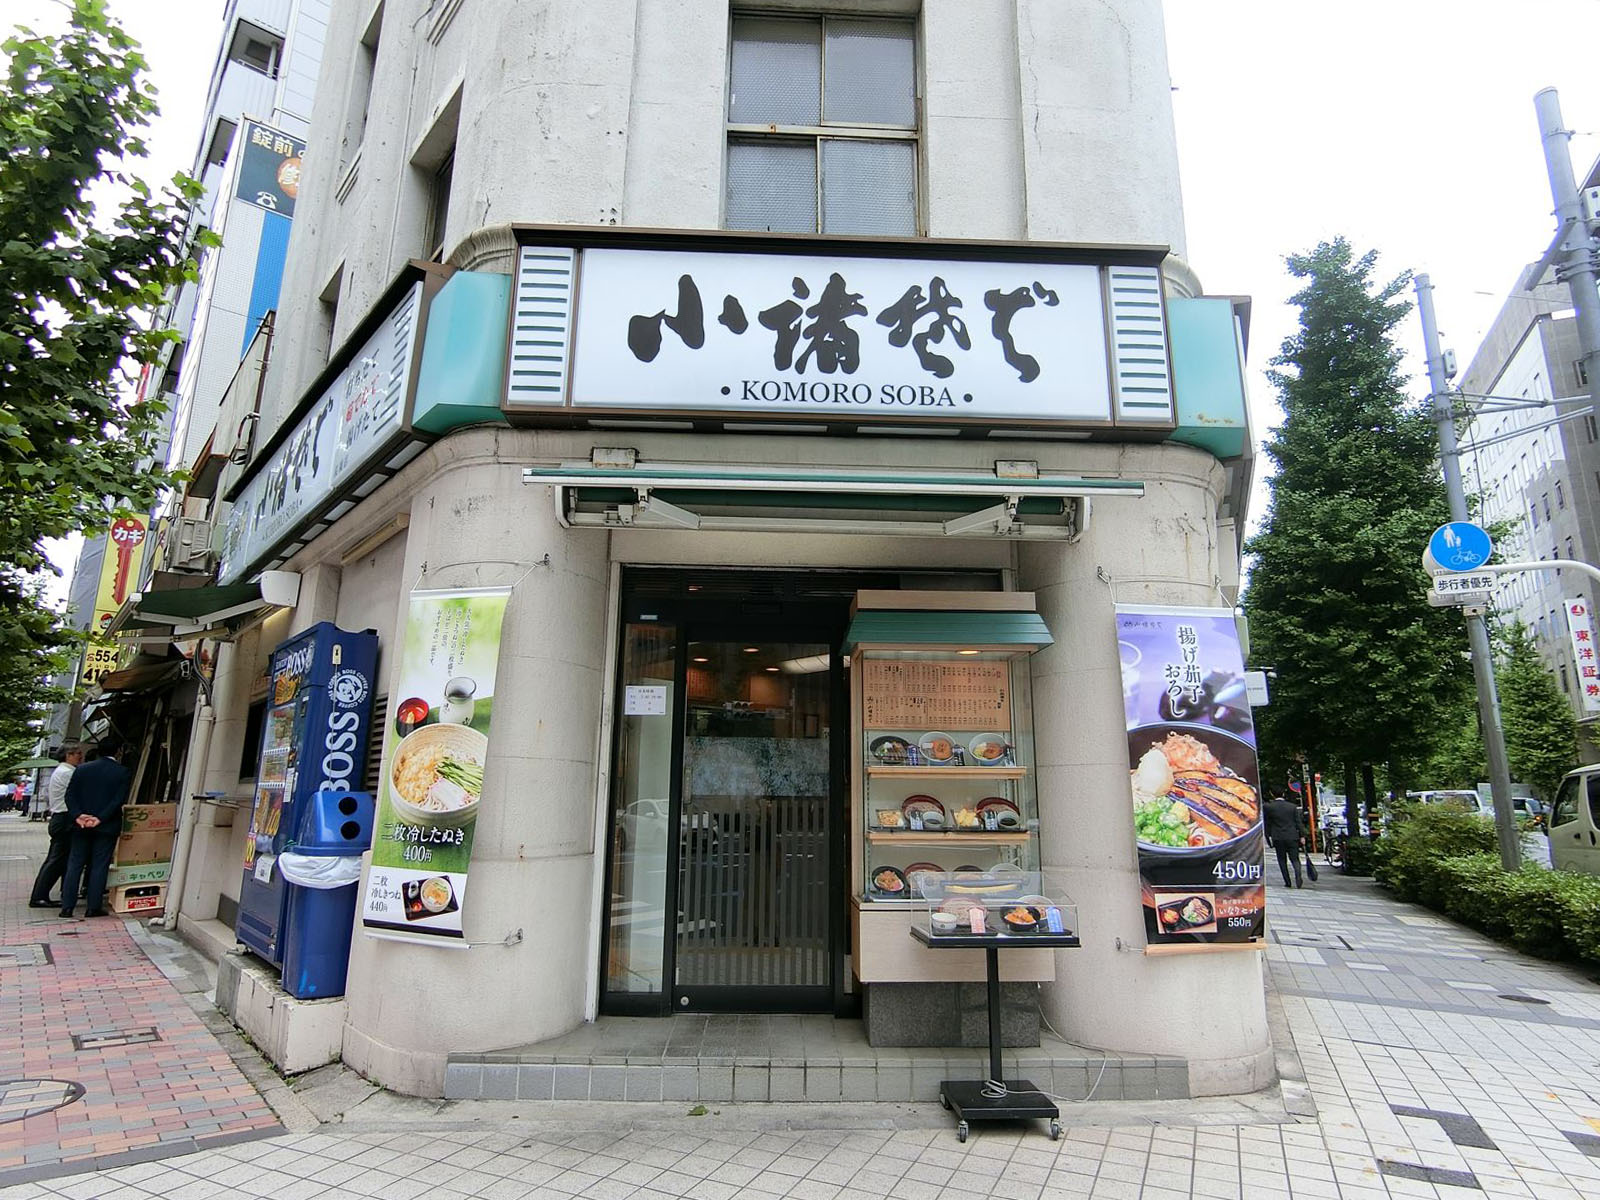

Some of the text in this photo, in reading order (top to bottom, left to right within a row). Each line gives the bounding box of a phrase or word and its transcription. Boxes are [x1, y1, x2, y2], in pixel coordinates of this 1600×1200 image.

[741, 380, 956, 407] KOMORO SOBA
[114, 527, 144, 542] カギ
[1438, 577, 1493, 590] 歩行者優先
[1178, 627, 1204, 703] 揚げ茄子
[1165, 664, 1186, 717] おろし
[319, 711, 360, 792] BOSS
[381, 823, 465, 845] 二枚冷したぬき
[403, 845, 433, 863] 400円
[1212, 860, 1261, 879] 450円
[373, 875, 388, 887] 二枚
[370, 887, 401, 900] 冷しきつね
[370, 901, 388, 913] 440円
[1218, 904, 1259, 915] いなりセット
[1228, 917, 1252, 927] 550円
